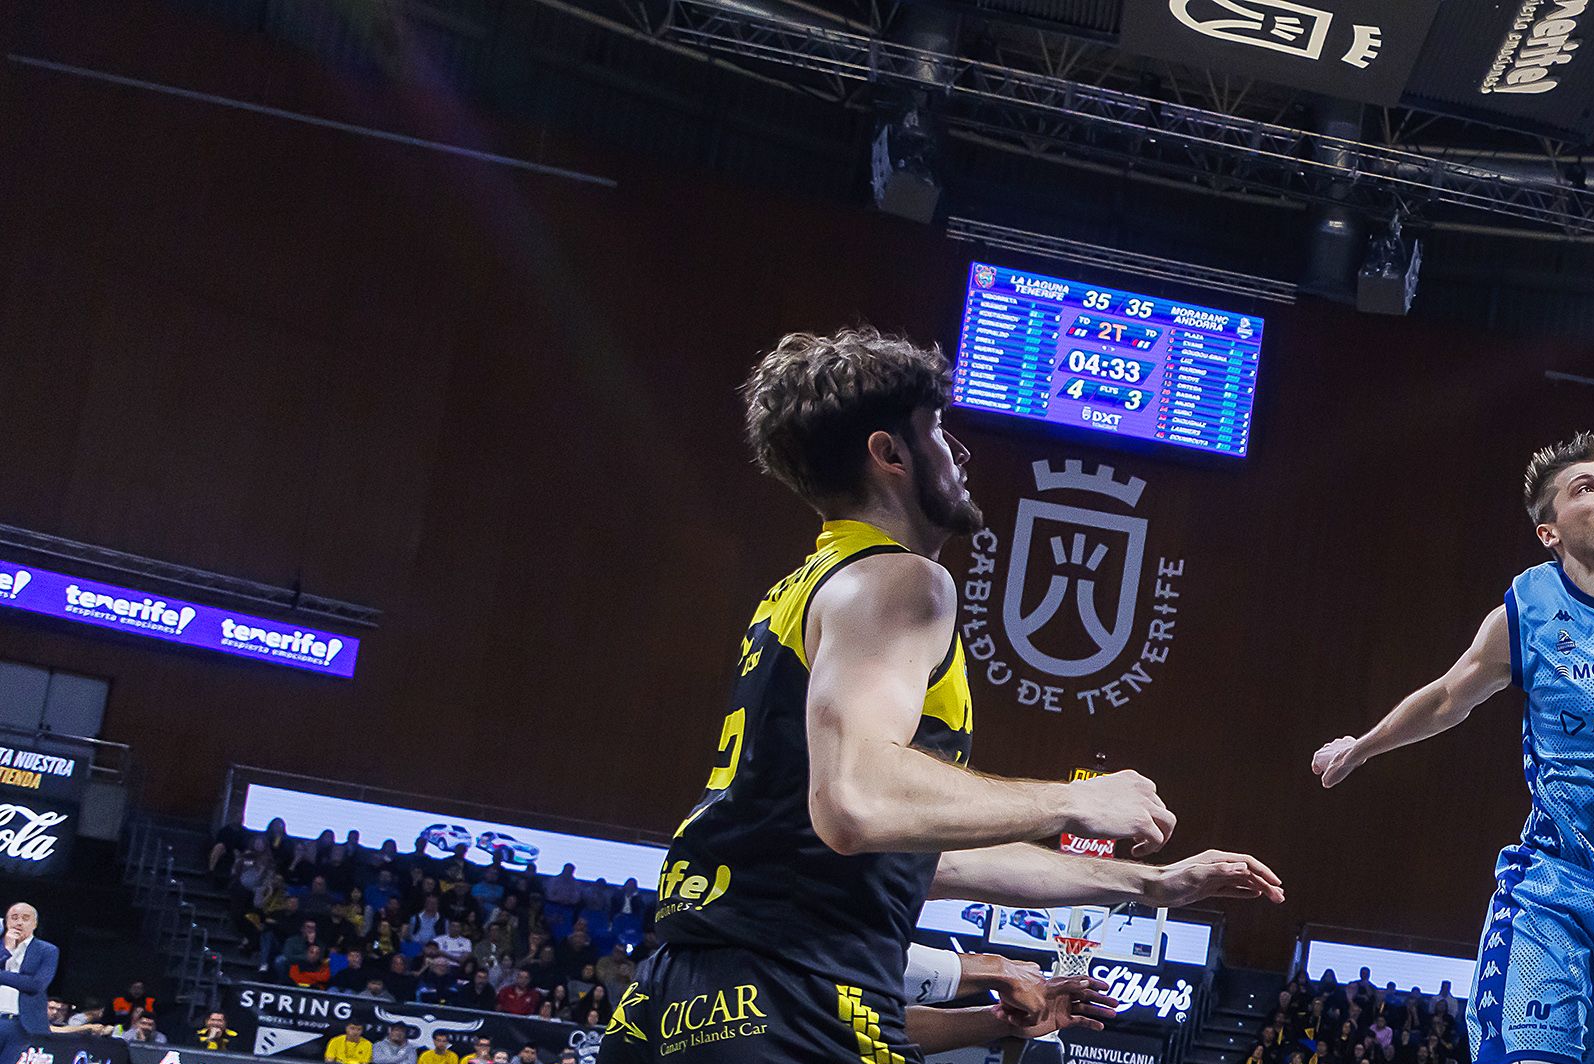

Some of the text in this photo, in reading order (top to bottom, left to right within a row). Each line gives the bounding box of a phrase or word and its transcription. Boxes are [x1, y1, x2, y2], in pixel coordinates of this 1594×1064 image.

[1010, 275, 1070, 294] LA LAGUNA
[1015, 283, 1065, 301] TENERIFE
[1083, 290, 1112, 311] 35
[1125, 298, 1155, 319] 35
[1171, 306, 1229, 325] MORABANC
[1174, 315, 1223, 332] ANDORRA
[1098, 321, 1127, 342] 2T
[1068, 350, 1140, 383] 04:33
[1067, 379, 1085, 400] 4
[1125, 390, 1143, 411] 3
[65, 584, 197, 635] tenerife!
[963, 527, 1185, 715] CABILDO DE TENERIFE
[221, 618, 344, 667] tenerife!
[13, 750, 75, 777] NUESTRA
[1061, 833, 1115, 858] Libby's
[1091, 965, 1193, 1018] Libby's
[240, 989, 352, 1021] SPRING
[661, 984, 767, 1039] CICAR
[690, 1026, 736, 1047] Islands
[739, 1022, 768, 1037] Car
